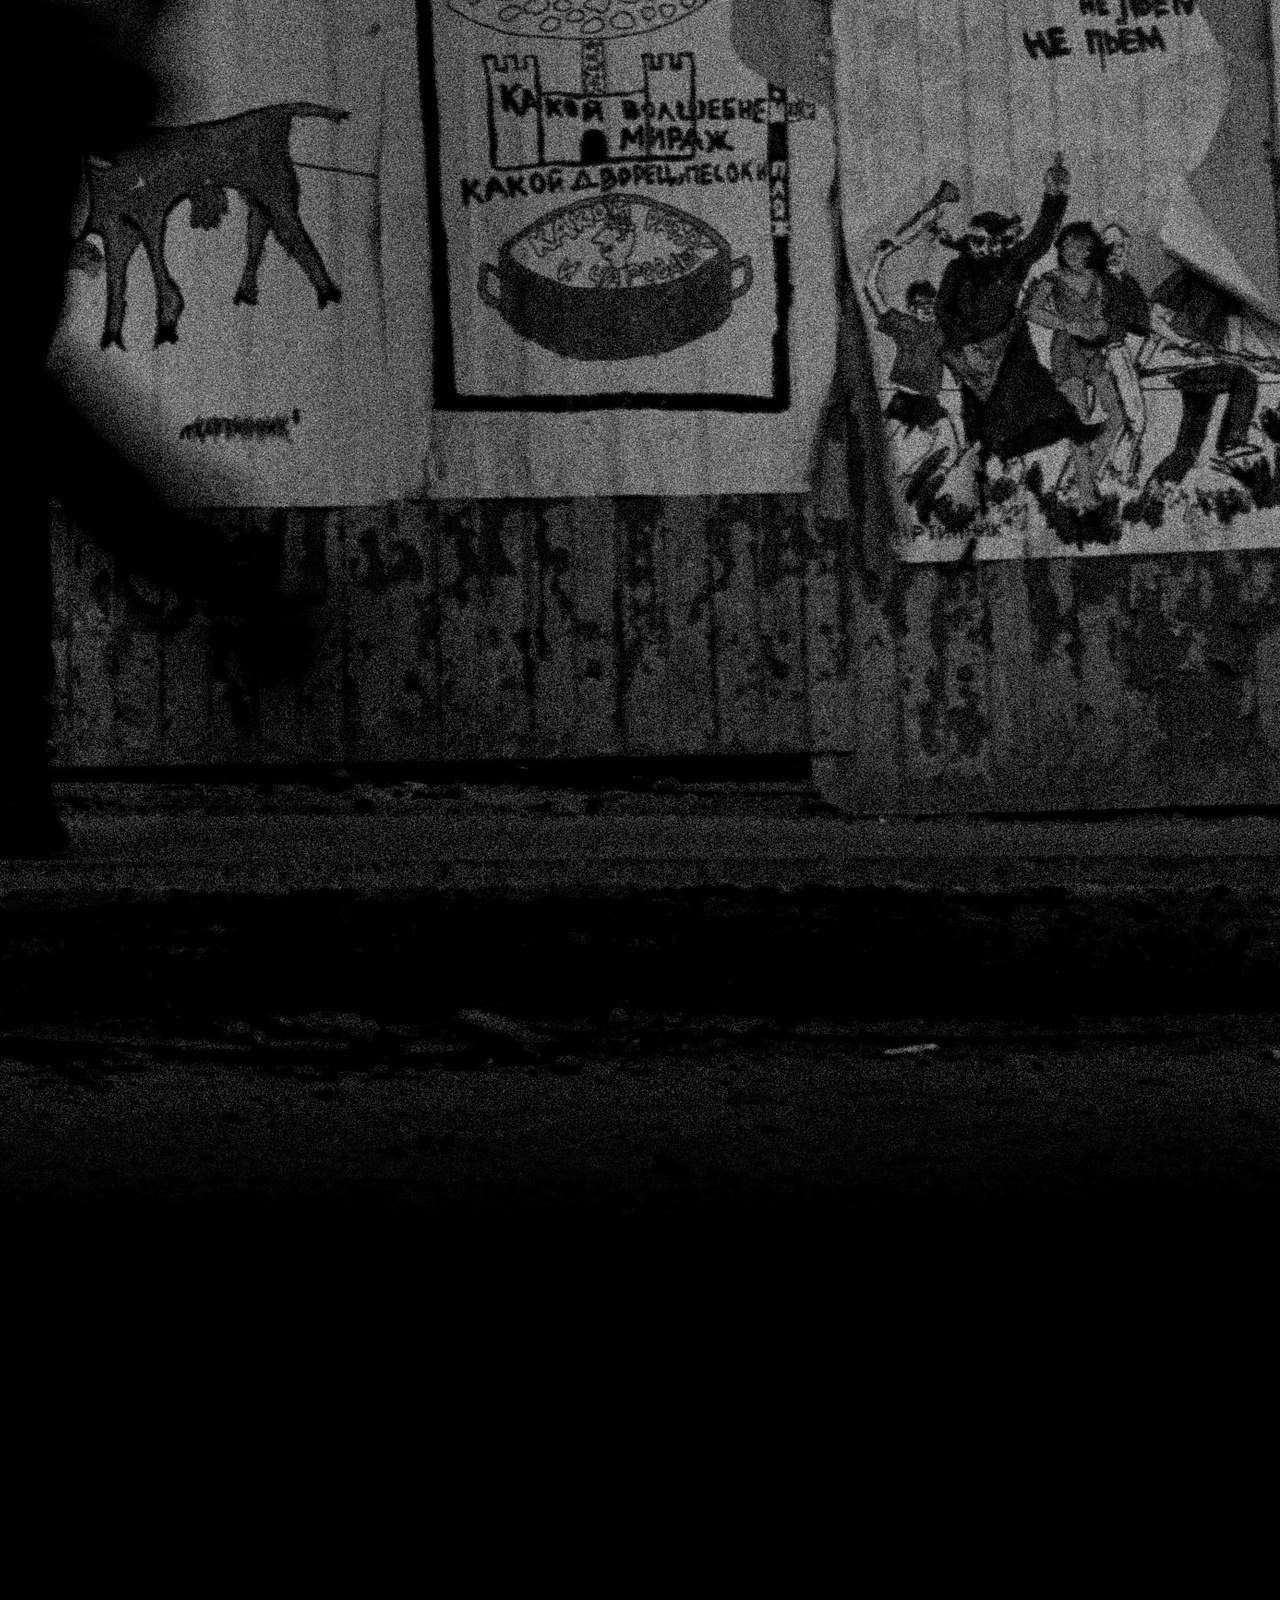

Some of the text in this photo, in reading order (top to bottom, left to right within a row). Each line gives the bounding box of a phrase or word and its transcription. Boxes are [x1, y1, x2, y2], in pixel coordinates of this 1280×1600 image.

[1023, 26, 1072, 60] НЕ
[619, 125, 734, 153] МИРАЖ
[460, 165, 564, 206] КАКОЙ
